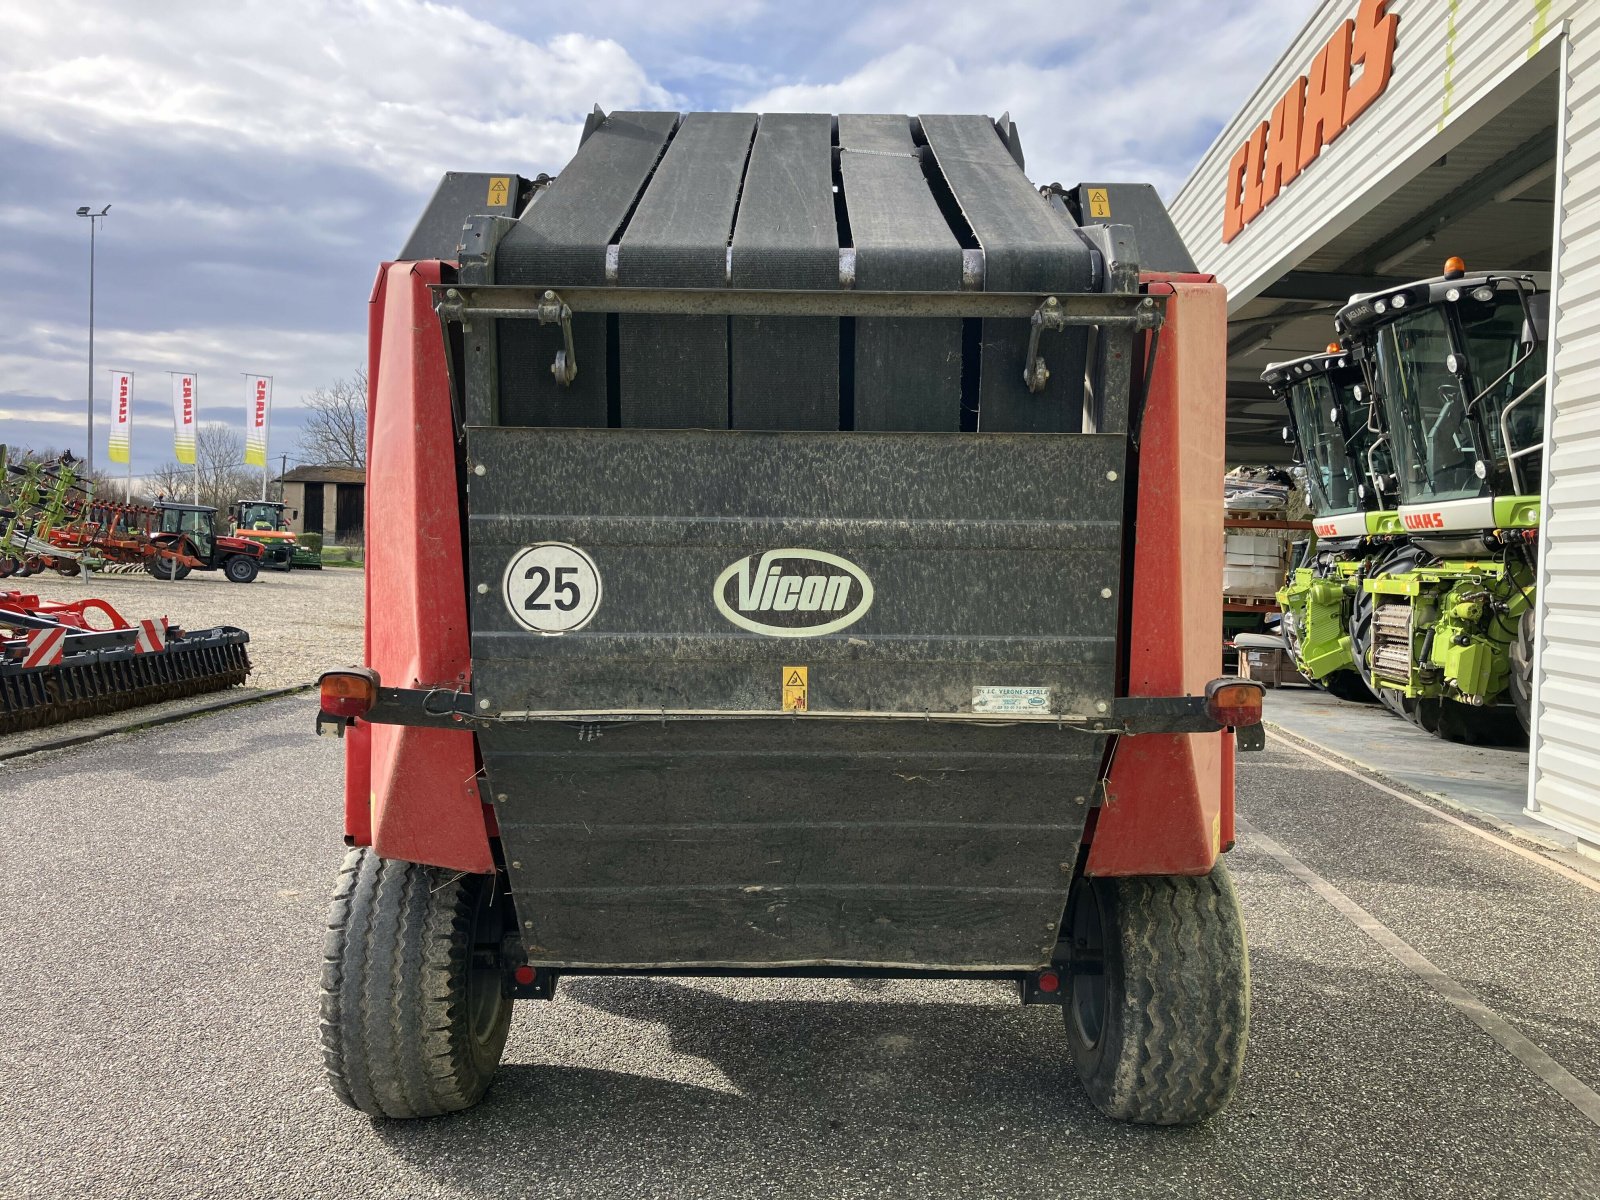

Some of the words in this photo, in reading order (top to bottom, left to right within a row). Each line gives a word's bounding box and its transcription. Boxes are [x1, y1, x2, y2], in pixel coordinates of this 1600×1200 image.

[1222, 0, 1400, 244] CLAAS
[1404, 512, 1444, 530] CLAAS
[524, 566, 581, 611] 25
[738, 551, 852, 612] Vicon
